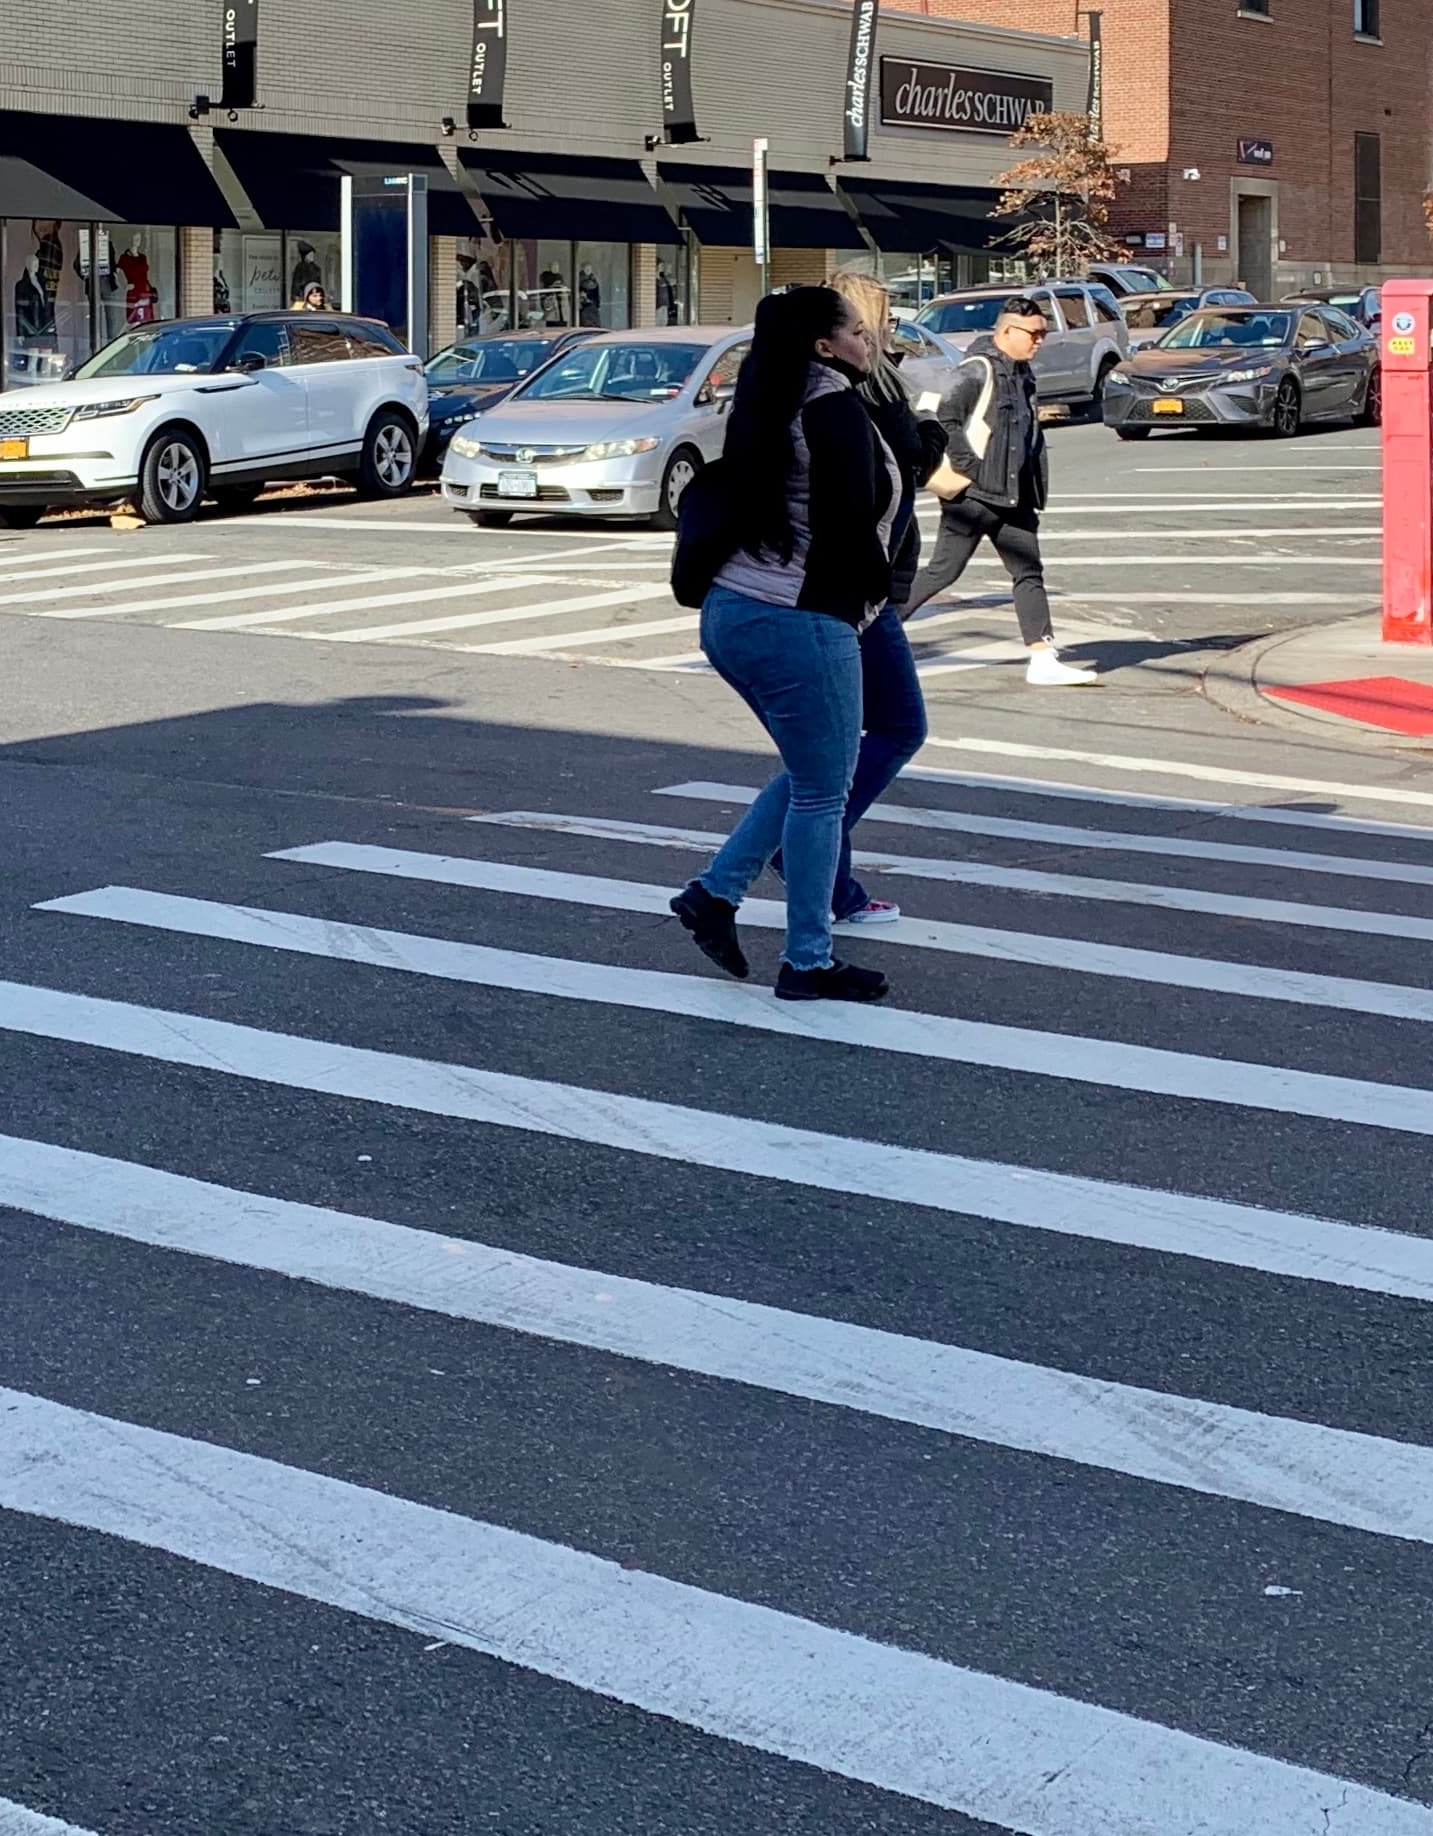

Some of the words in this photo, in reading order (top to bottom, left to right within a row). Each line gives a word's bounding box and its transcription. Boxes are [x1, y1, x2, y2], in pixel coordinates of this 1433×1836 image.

[225, 9, 236, 68] OUTLET
[472, 42, 487, 95] OUTLET
[663, 62, 674, 111] OUTLET
[895, 67, 974, 121] charles
